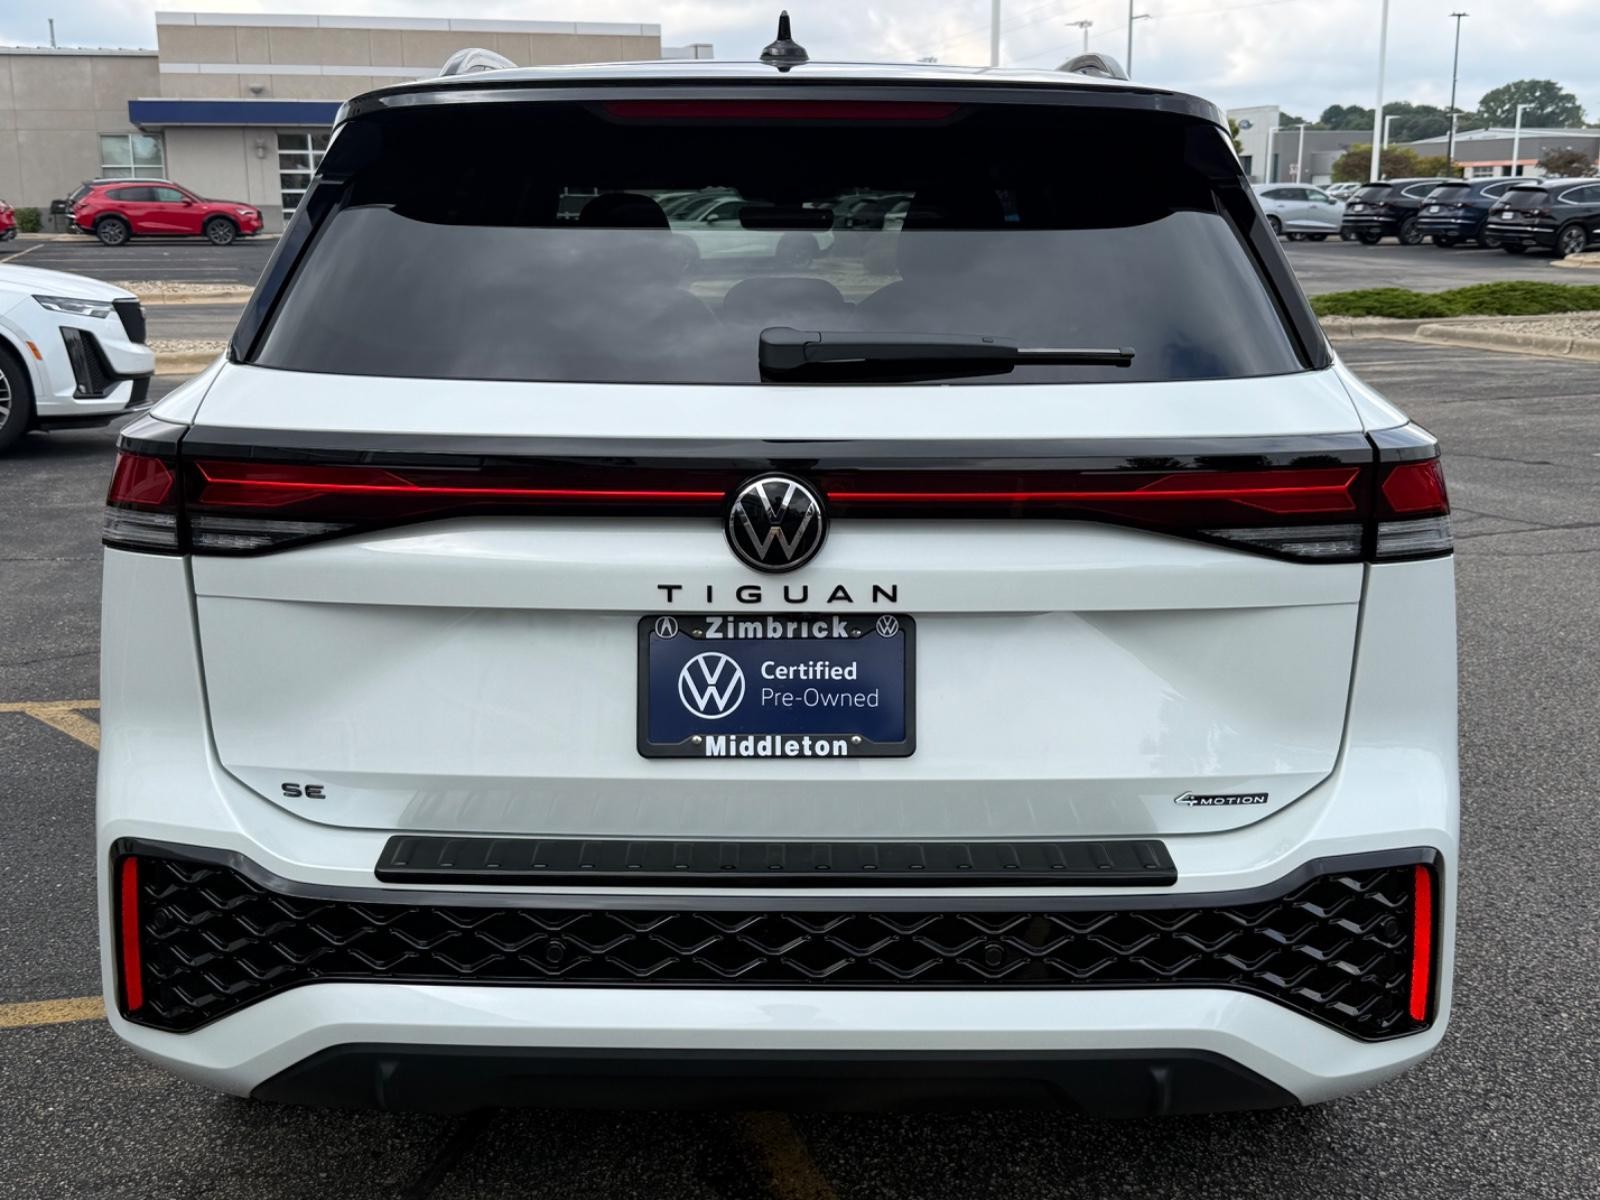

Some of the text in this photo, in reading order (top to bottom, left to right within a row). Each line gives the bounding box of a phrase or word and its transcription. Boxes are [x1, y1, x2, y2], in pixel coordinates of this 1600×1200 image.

[657, 584, 898, 604] TIGUAN
[705, 616, 849, 639] Zimbrick
[761, 661, 857, 680] Certified
[761, 688, 879, 707] Pre-Owned
[705, 735, 848, 757] Middleton
[281, 783, 326, 799] SE
[1174, 791, 1267, 806] 4MOTION
